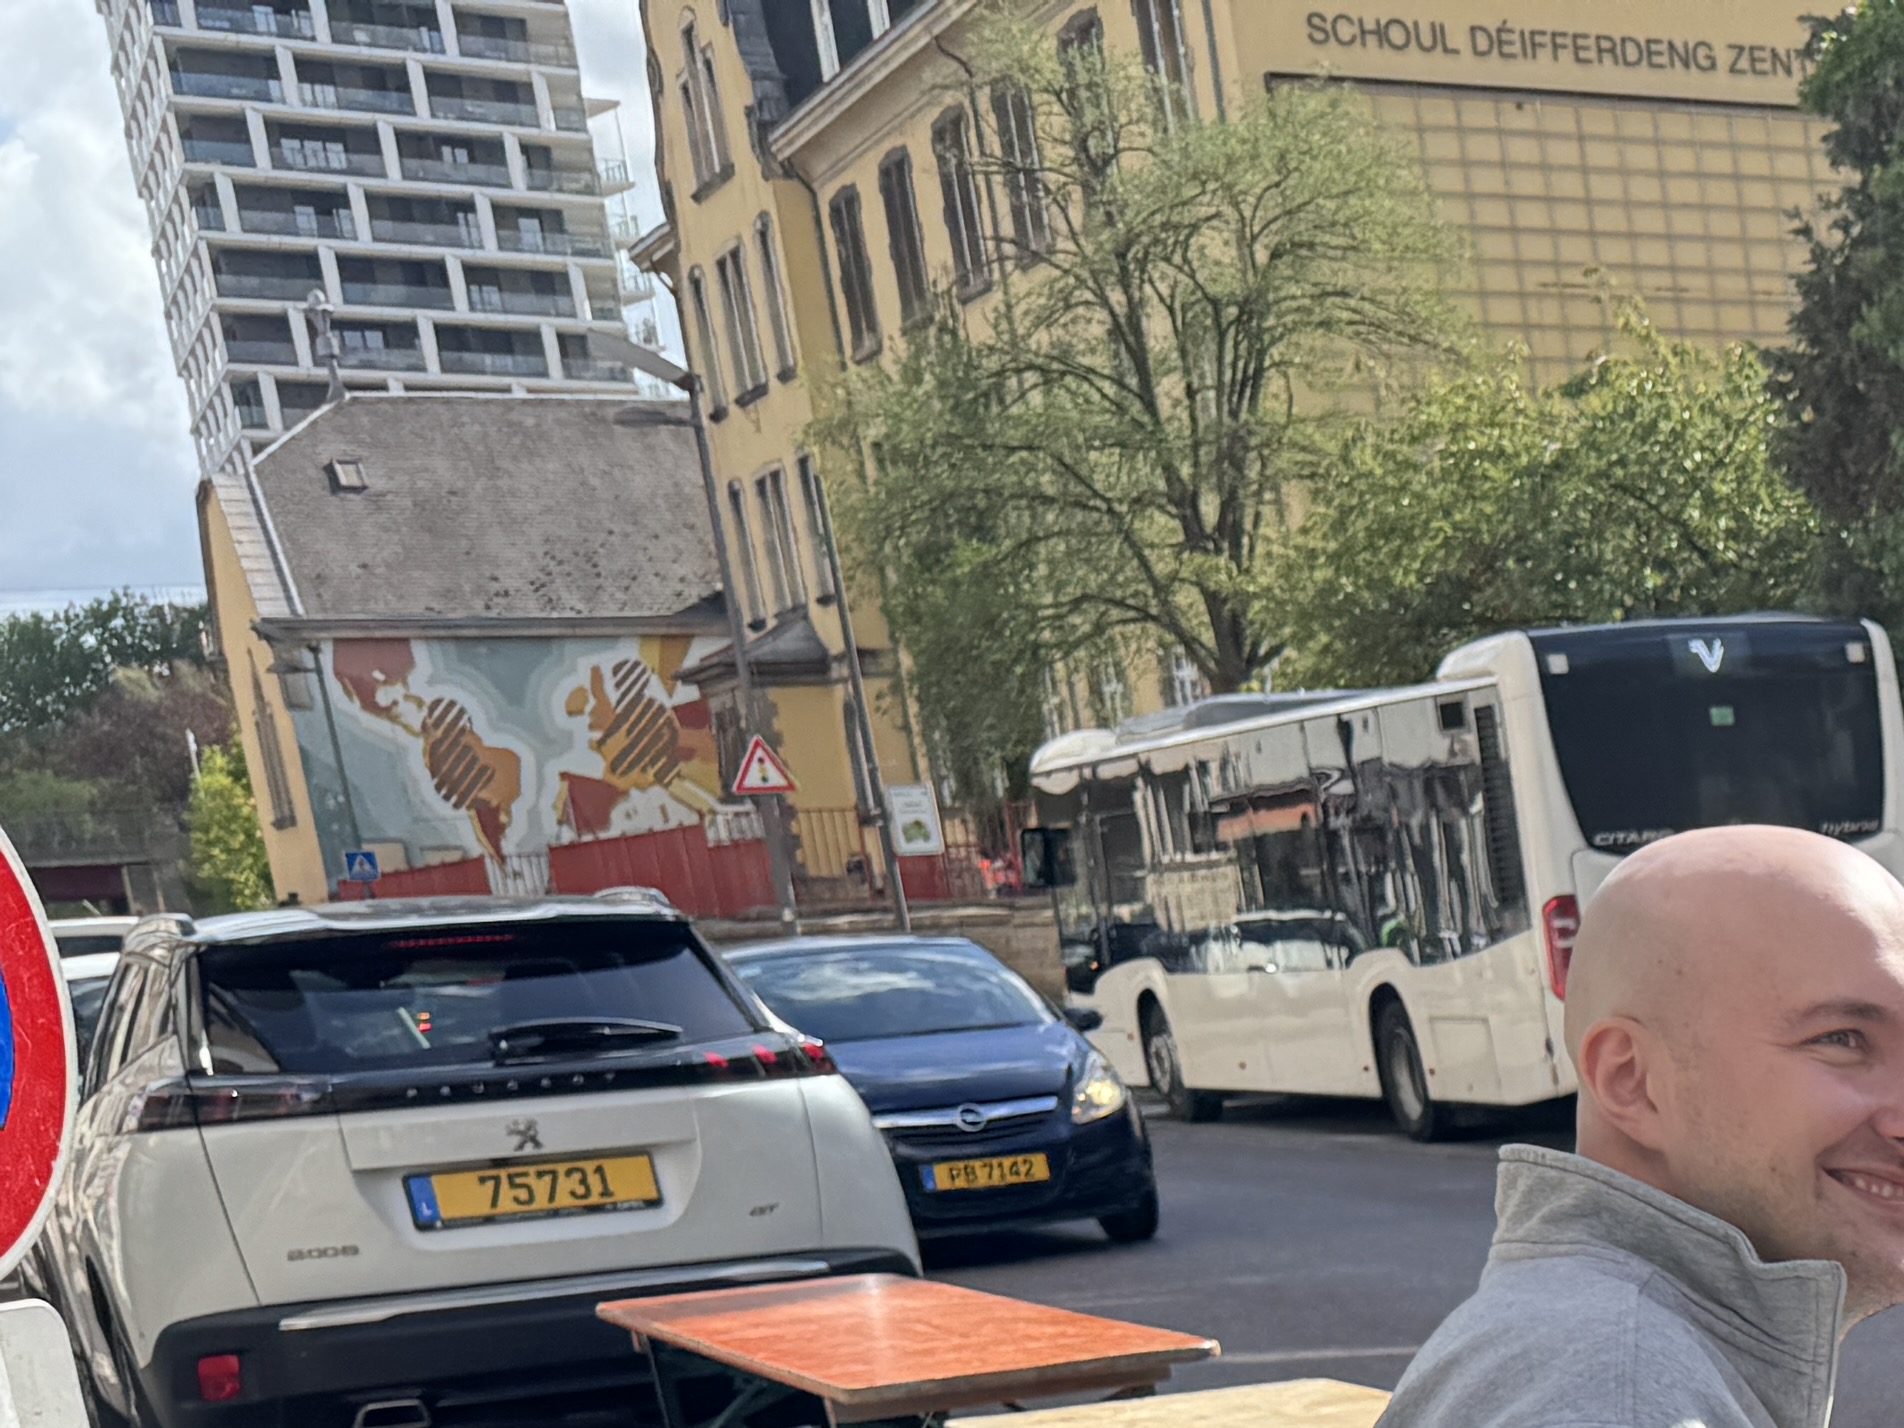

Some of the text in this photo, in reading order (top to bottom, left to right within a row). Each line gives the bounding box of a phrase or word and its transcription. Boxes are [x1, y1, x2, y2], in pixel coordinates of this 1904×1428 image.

[1305, 11, 1461, 55] SCHOUL
[1469, 20, 1718, 72] DÉIFFERDENG
[477, 1163, 615, 1210] 75731
